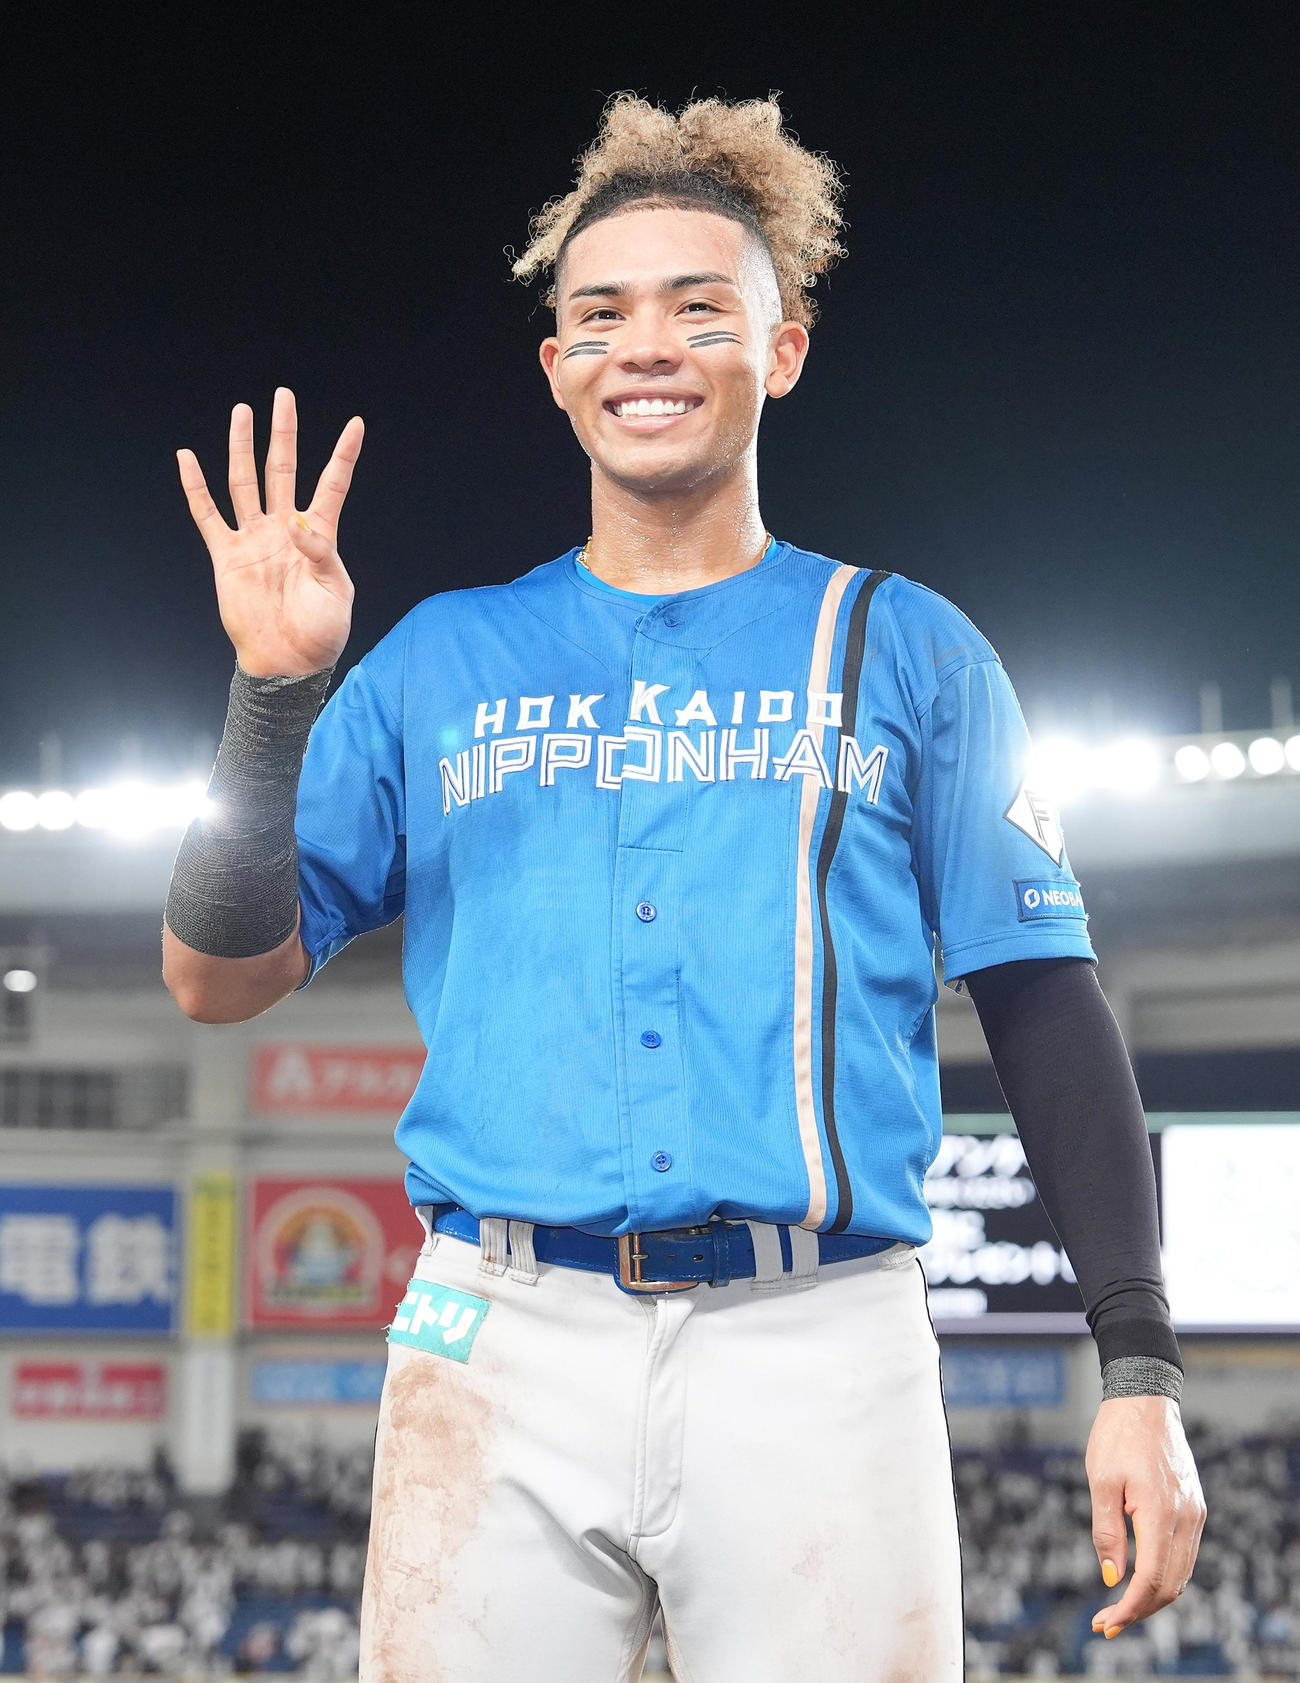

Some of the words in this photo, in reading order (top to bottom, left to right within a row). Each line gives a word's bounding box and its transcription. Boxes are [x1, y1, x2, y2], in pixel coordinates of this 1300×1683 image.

[474, 680, 843, 738] HOKKAIDO
[438, 728, 889, 816] NIPPONHAM
[391, 1291, 478, 1345] ニトリ
